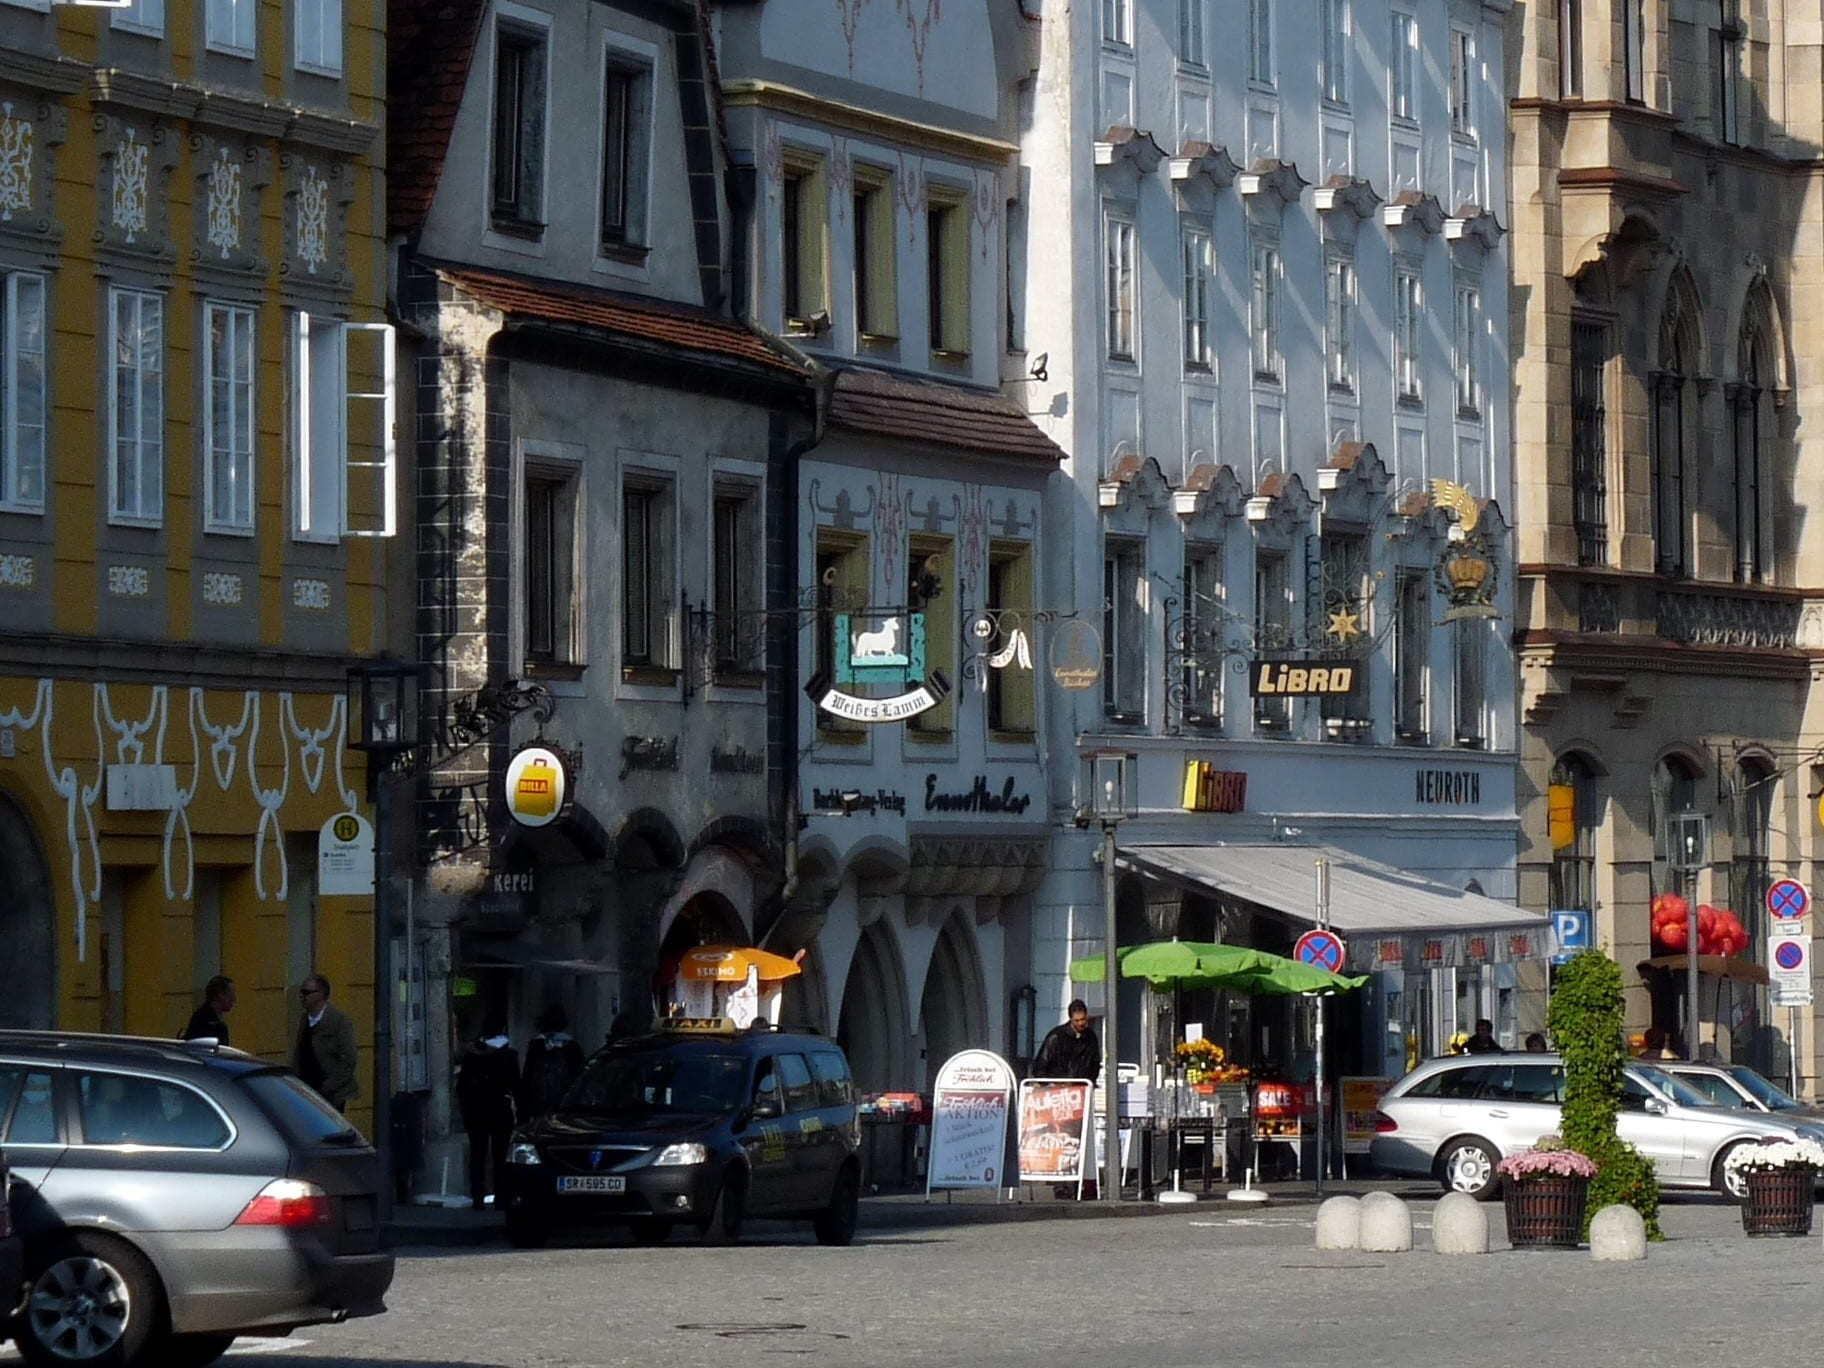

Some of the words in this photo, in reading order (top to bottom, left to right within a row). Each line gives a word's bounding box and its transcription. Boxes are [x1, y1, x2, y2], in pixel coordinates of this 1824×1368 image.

[831, 694, 879, 718] Weißes
[881, 695, 927, 717] Lamm
[1416, 770, 1480, 805] NEUROTH
[1558, 915, 1580, 941] P
[697, 967, 735, 976] ESKIMO
[672, 1019, 715, 1029] TAXI
[1258, 1091, 1291, 1107] SALE
[944, 1108, 999, 1121] AKTION
[566, 1178, 579, 1189] SR
